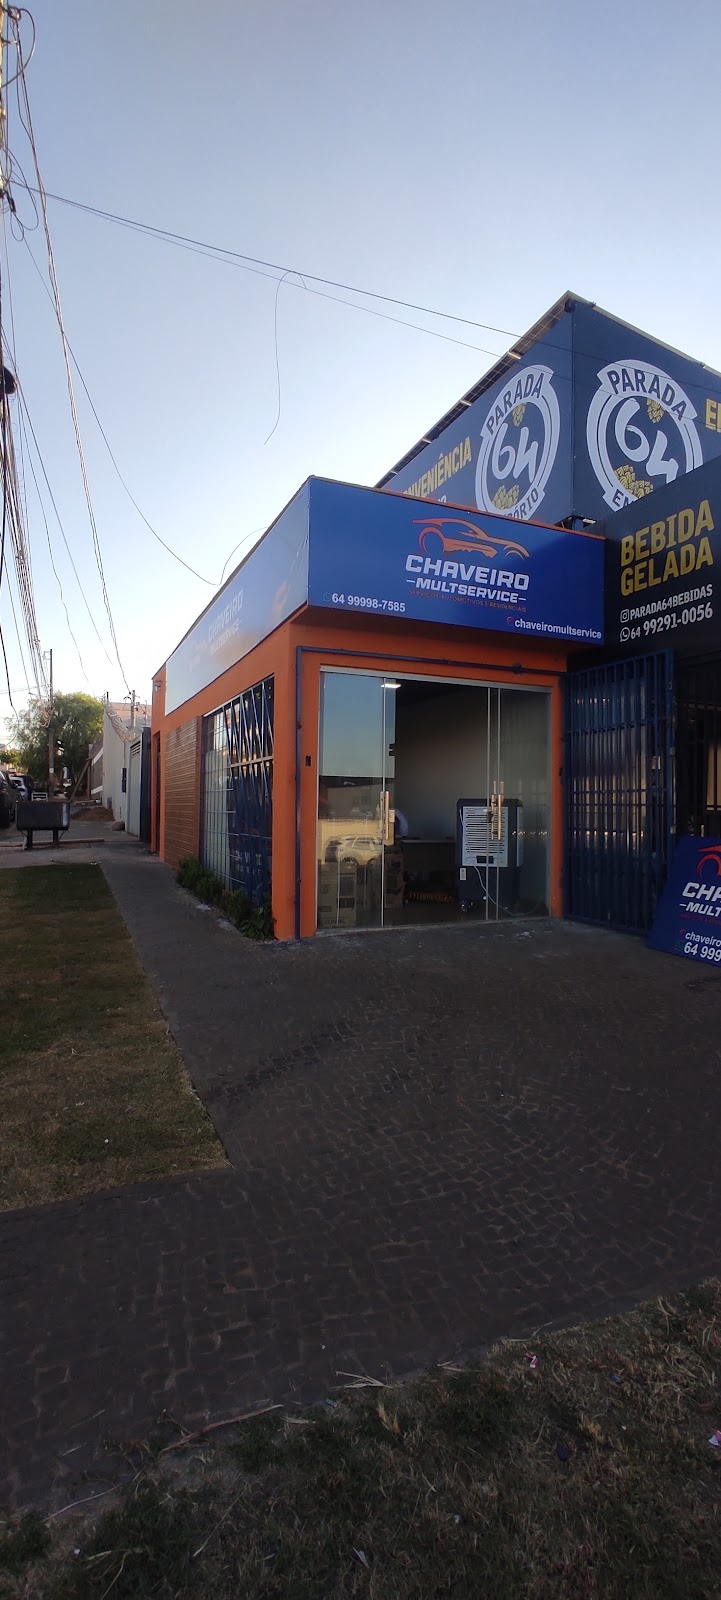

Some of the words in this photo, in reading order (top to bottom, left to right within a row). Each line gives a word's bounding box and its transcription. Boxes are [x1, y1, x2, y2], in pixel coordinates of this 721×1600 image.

[486, 372, 544, 434] PARADA
[606, 367, 686, 421] PARADA
[705, 398, 721, 432] E
[403, 436, 472, 498] NVENIÊNCIA
[491, 422, 539, 484] 64
[615, 397, 679, 483] 64
[620, 499, 715, 567] BEBIDA
[405, 554, 530, 591] CHAVEIRO
[620, 536, 714, 596] GELADA
[208, 588, 244, 643] CHAVEIRO
[331, 592, 345, 605] 64
[347, 595, 406, 613] 99998-7585
[514, 618, 602, 640] chaveiromultservice
[630, 584, 713, 621] PARADA64BEBIDAS
[630, 626, 641, 640] 64
[642, 601, 713, 636] 99291-0056
[684, 942, 698, 956] 64
[700, 946, 721, 962] 999
